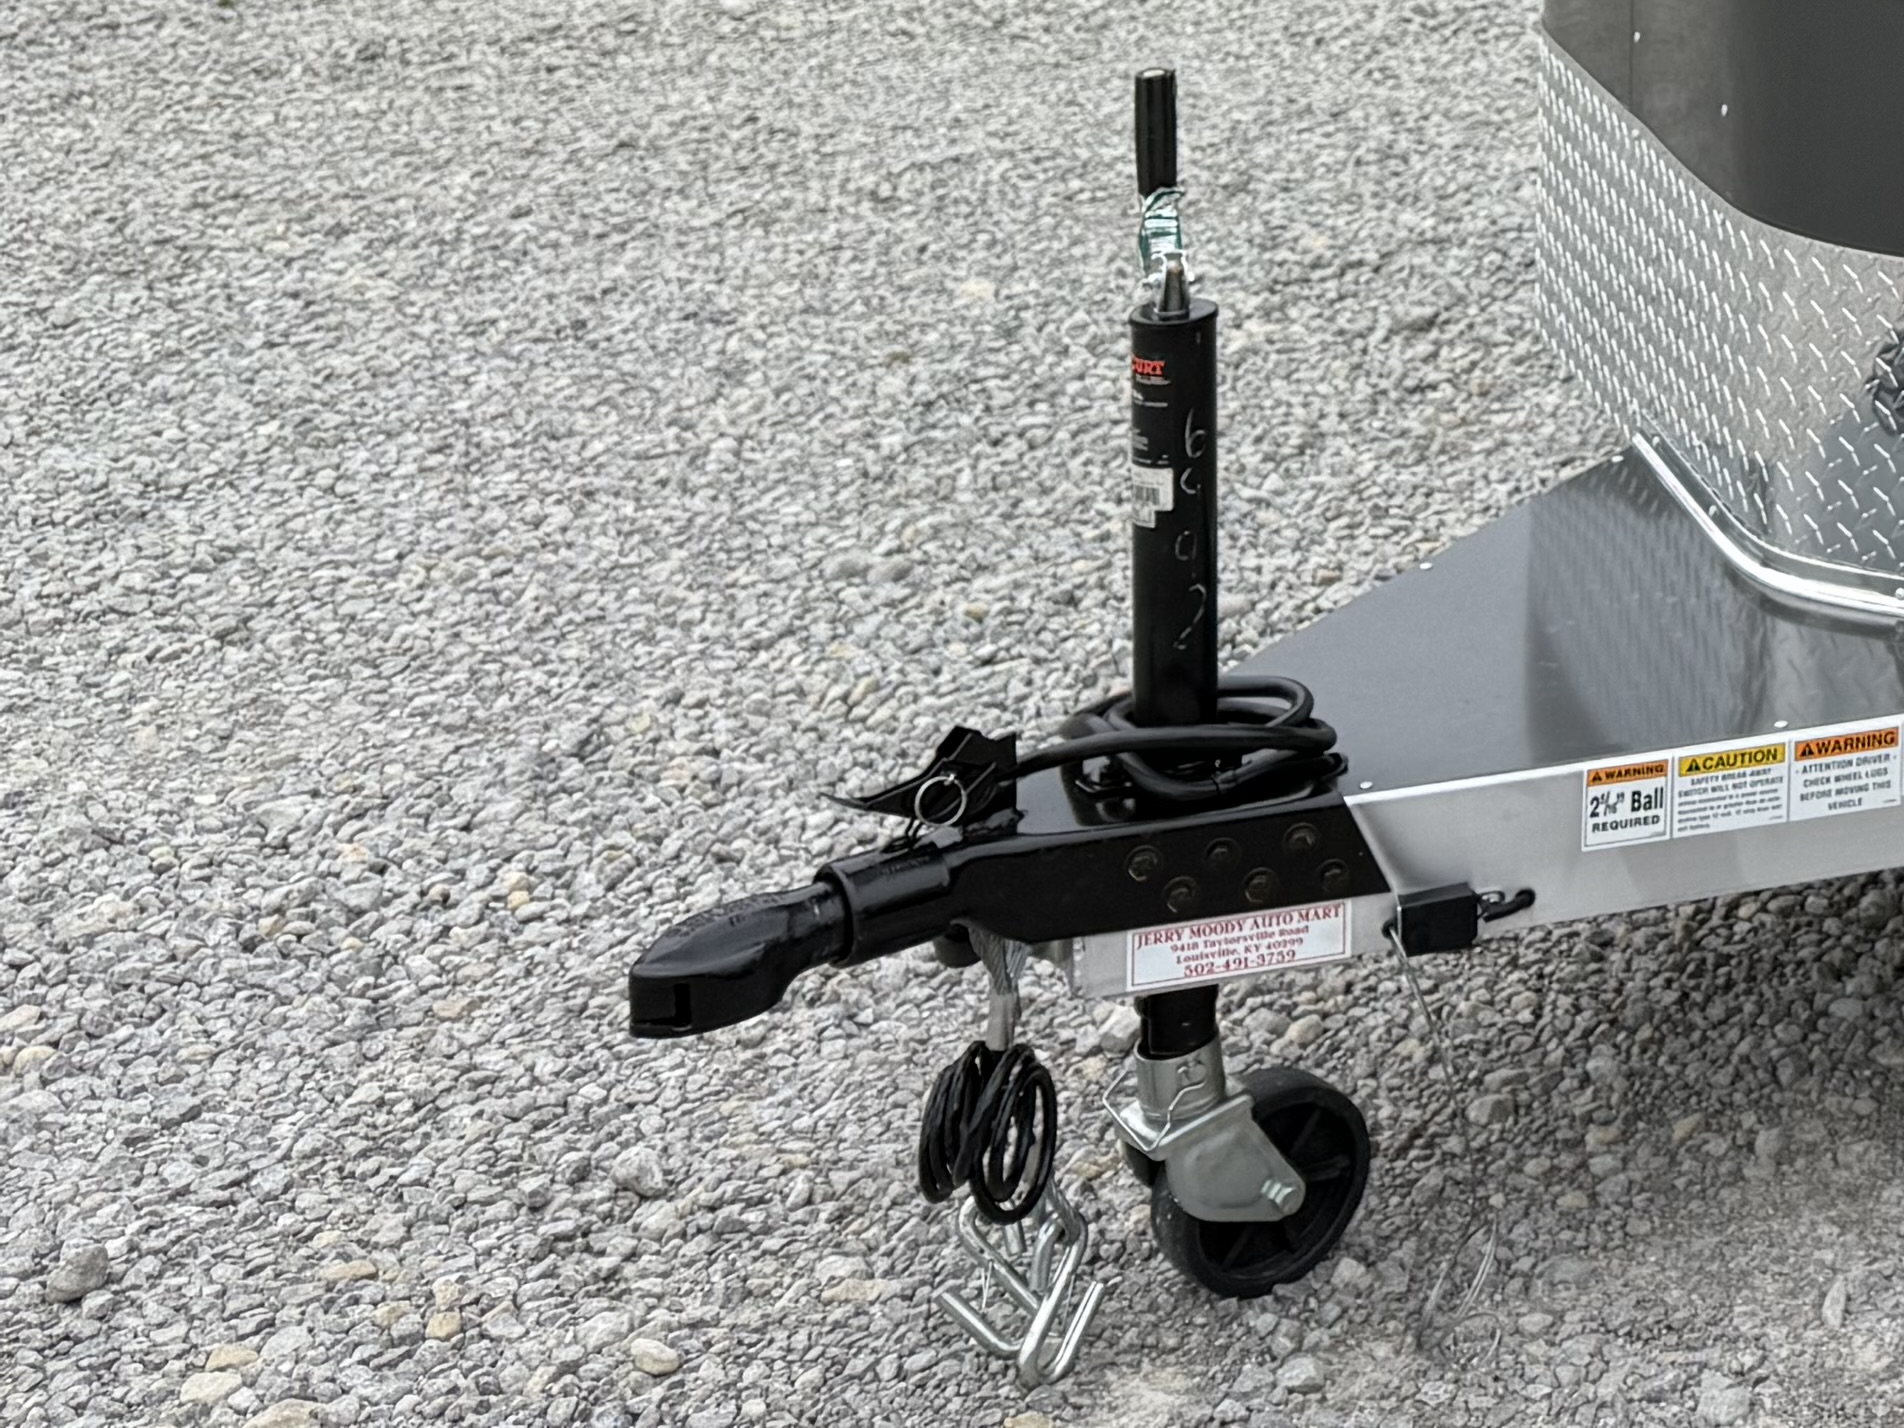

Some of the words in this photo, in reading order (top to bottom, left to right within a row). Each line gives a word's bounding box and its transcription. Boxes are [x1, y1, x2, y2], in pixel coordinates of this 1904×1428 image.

[1816, 731, 1896, 755] WARNING
[1703, 748, 1778, 771] CAUTION
[1801, 759, 1853, 774] ATTENTION
[1605, 763, 1665, 780] WARNING
[1630, 787, 1664, 813] Ball
[1592, 815, 1661, 834] REQUIRED
[1137, 927, 1185, 950] JERRY
[1189, 919, 1246, 939] MOODY
[1250, 911, 1294, 931] AUTO
[1297, 903, 1342, 923] MART
